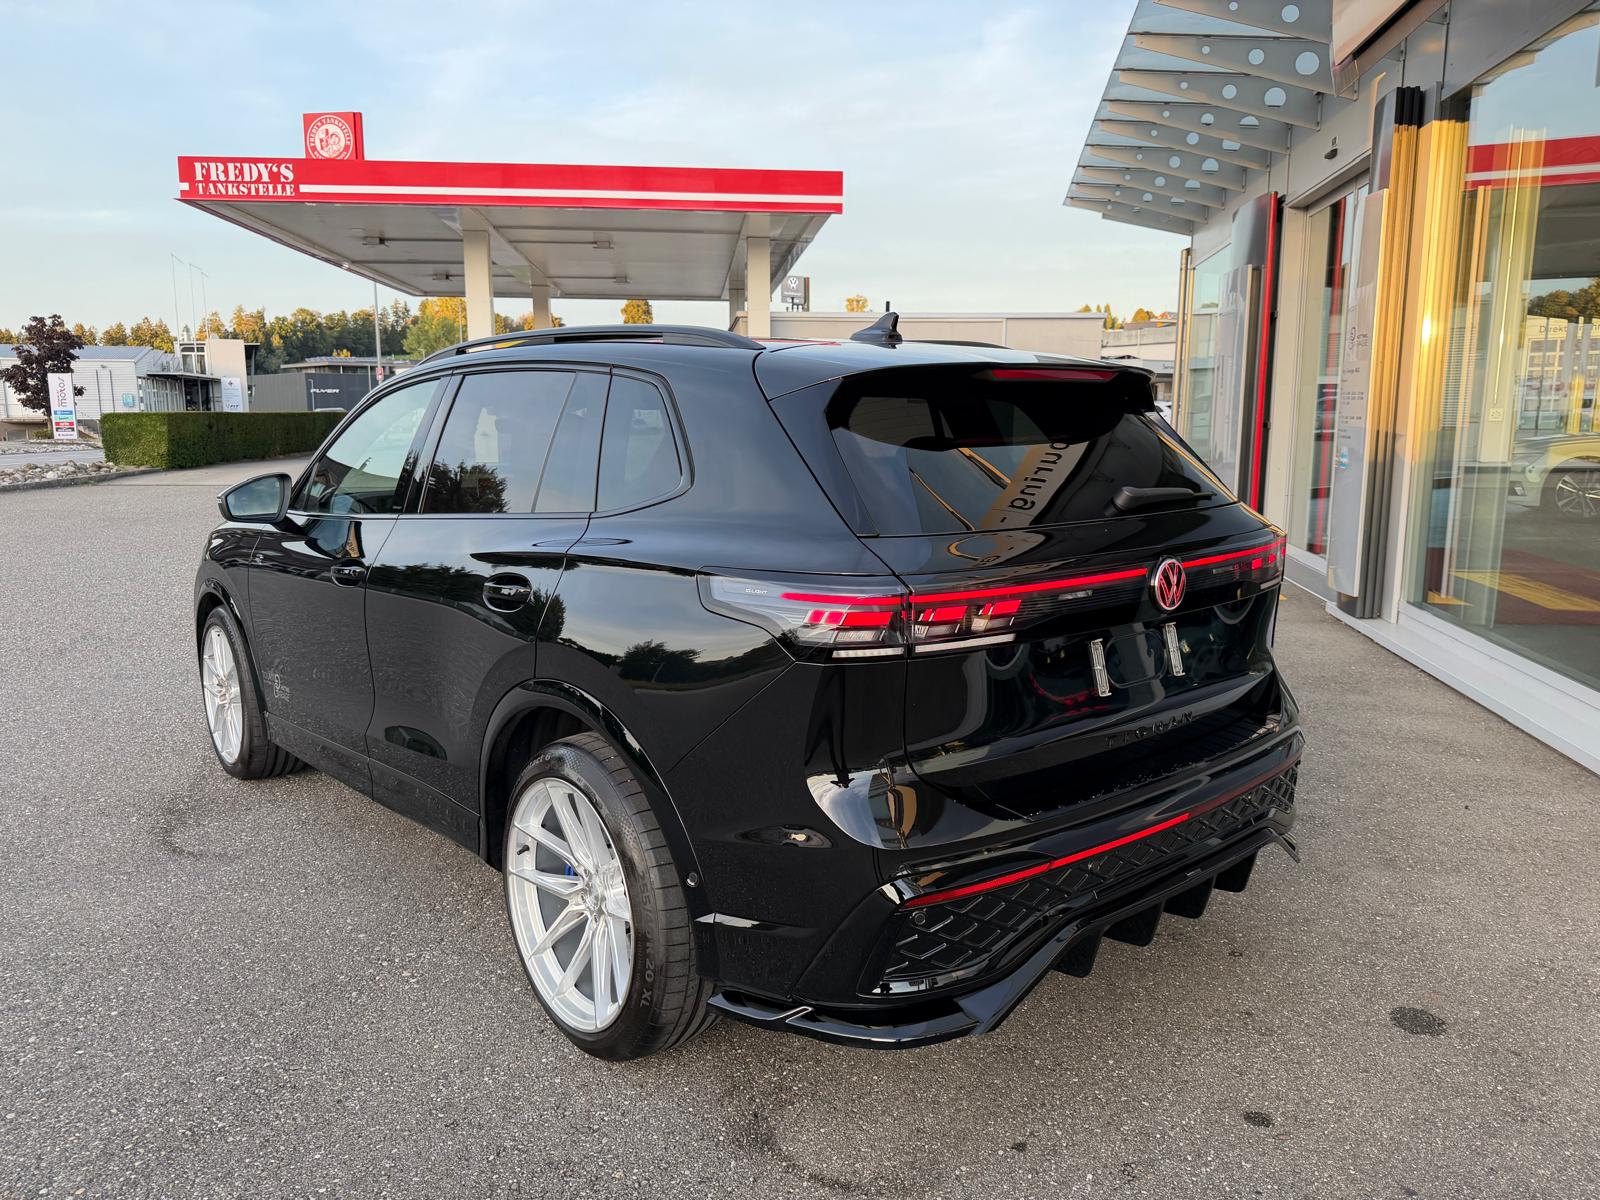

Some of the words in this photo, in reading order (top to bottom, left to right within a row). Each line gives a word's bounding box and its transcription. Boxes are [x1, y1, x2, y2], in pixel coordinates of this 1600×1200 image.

[322, 117, 351, 146] TANKSTELLE
[193, 161, 294, 183] FREDY'S
[196, 182, 295, 197] TANKSTELLE
[1105, 711, 1193, 748] TIGUAN
[645, 958, 655, 982] 20
[640, 988, 652, 1007] XL
